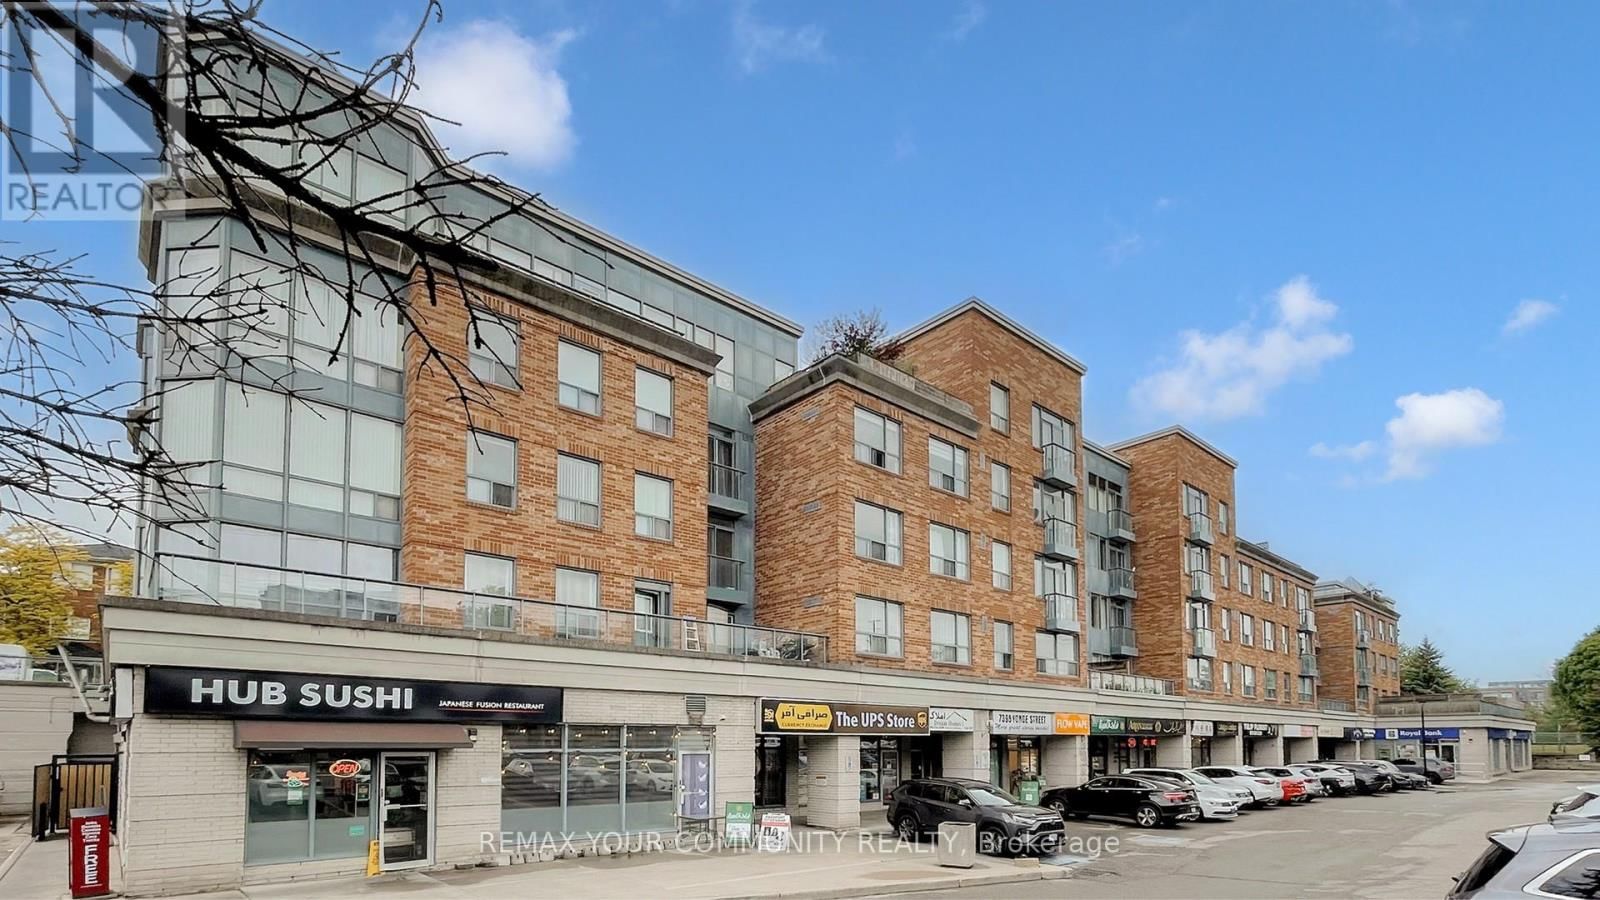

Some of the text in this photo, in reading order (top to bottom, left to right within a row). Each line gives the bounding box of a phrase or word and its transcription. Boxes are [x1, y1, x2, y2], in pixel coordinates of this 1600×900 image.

[191, 678, 413, 709] HUB SUSHI
[438, 700, 545, 710] JAPANESE FUSION RESTAURANT
[835, 711, 859, 727] The
[861, 712, 885, 728] UPS
[887, 713, 915, 728] Store
[1029, 715, 1046, 725] STREET
[1400, 729, 1421, 737] Royal
[333, 763, 358, 774] OPEN
